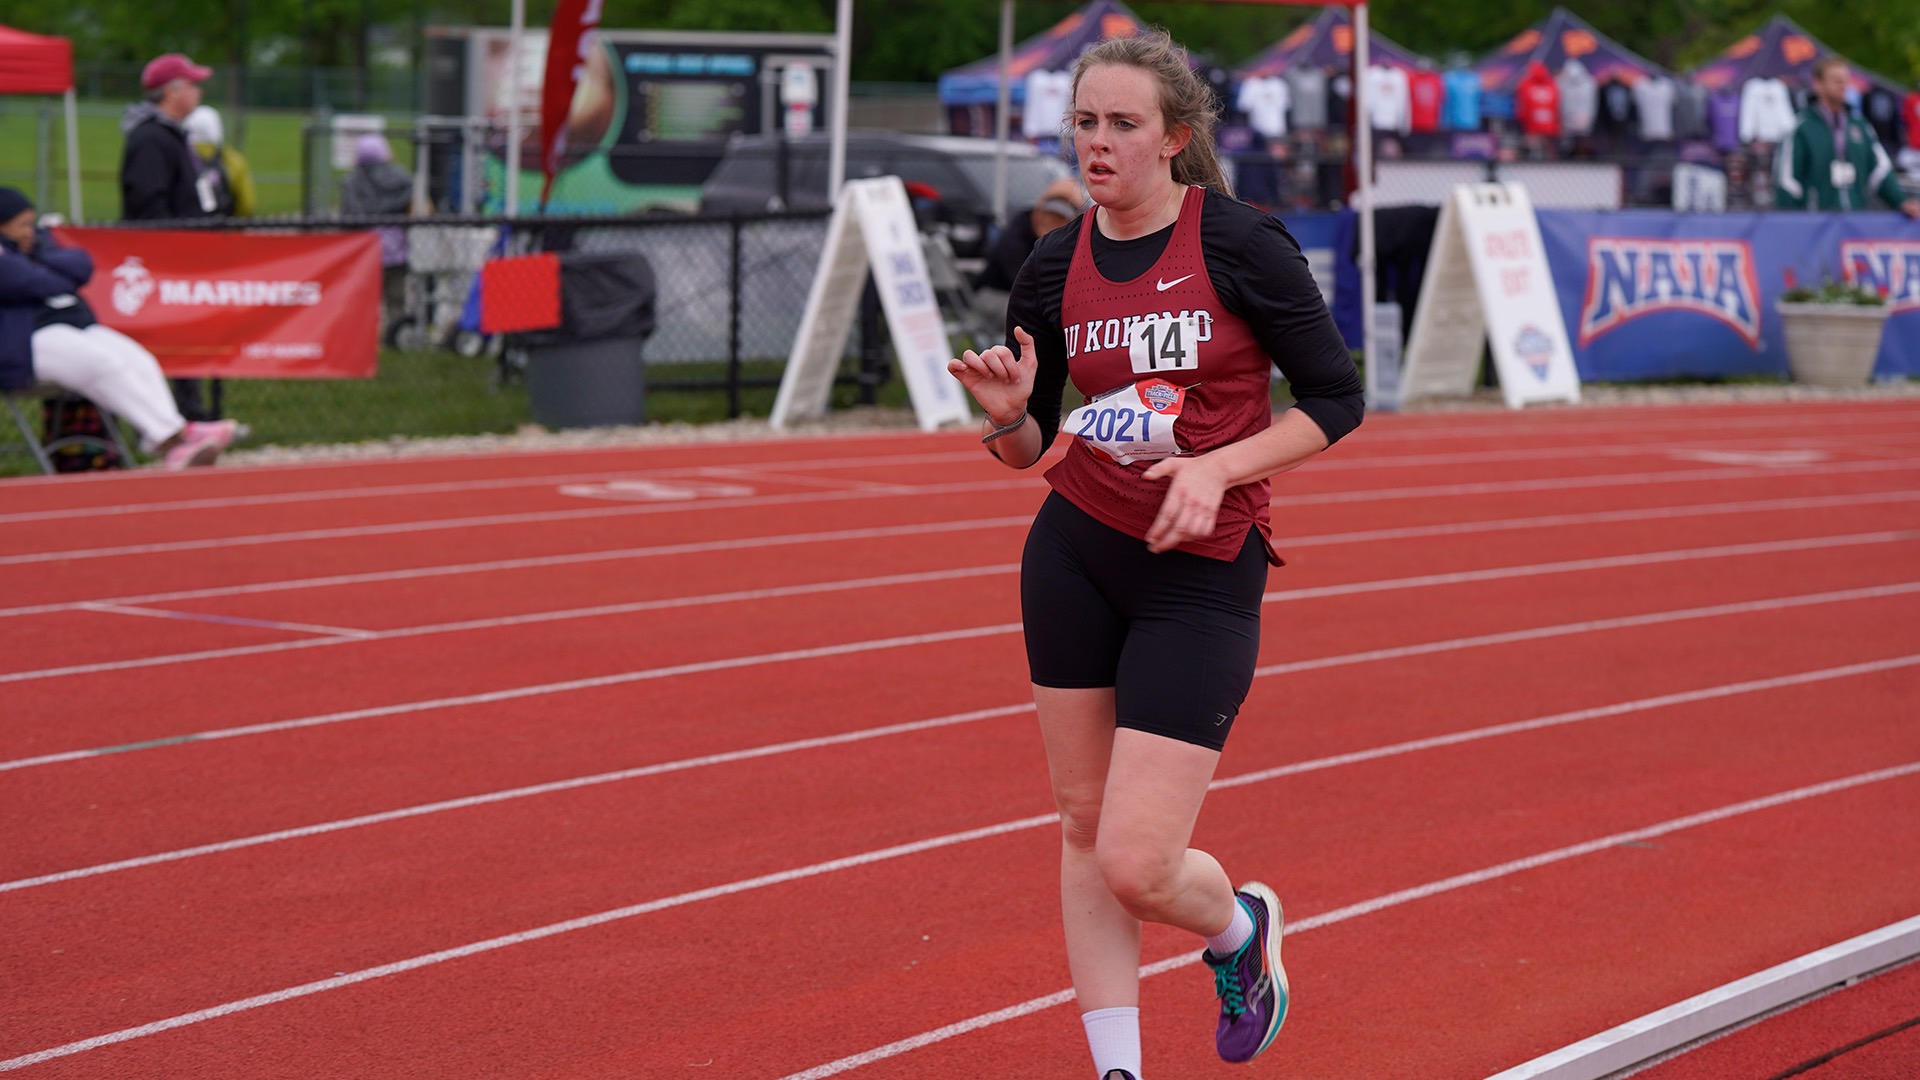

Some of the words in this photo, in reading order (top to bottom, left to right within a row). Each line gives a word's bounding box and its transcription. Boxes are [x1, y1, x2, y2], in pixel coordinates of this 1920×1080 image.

[158, 279, 322, 307] MARINES
[1582, 242, 1758, 342] NAIA
[1139, 321, 1186, 369] 14
[1077, 408, 1153, 442] 2021
